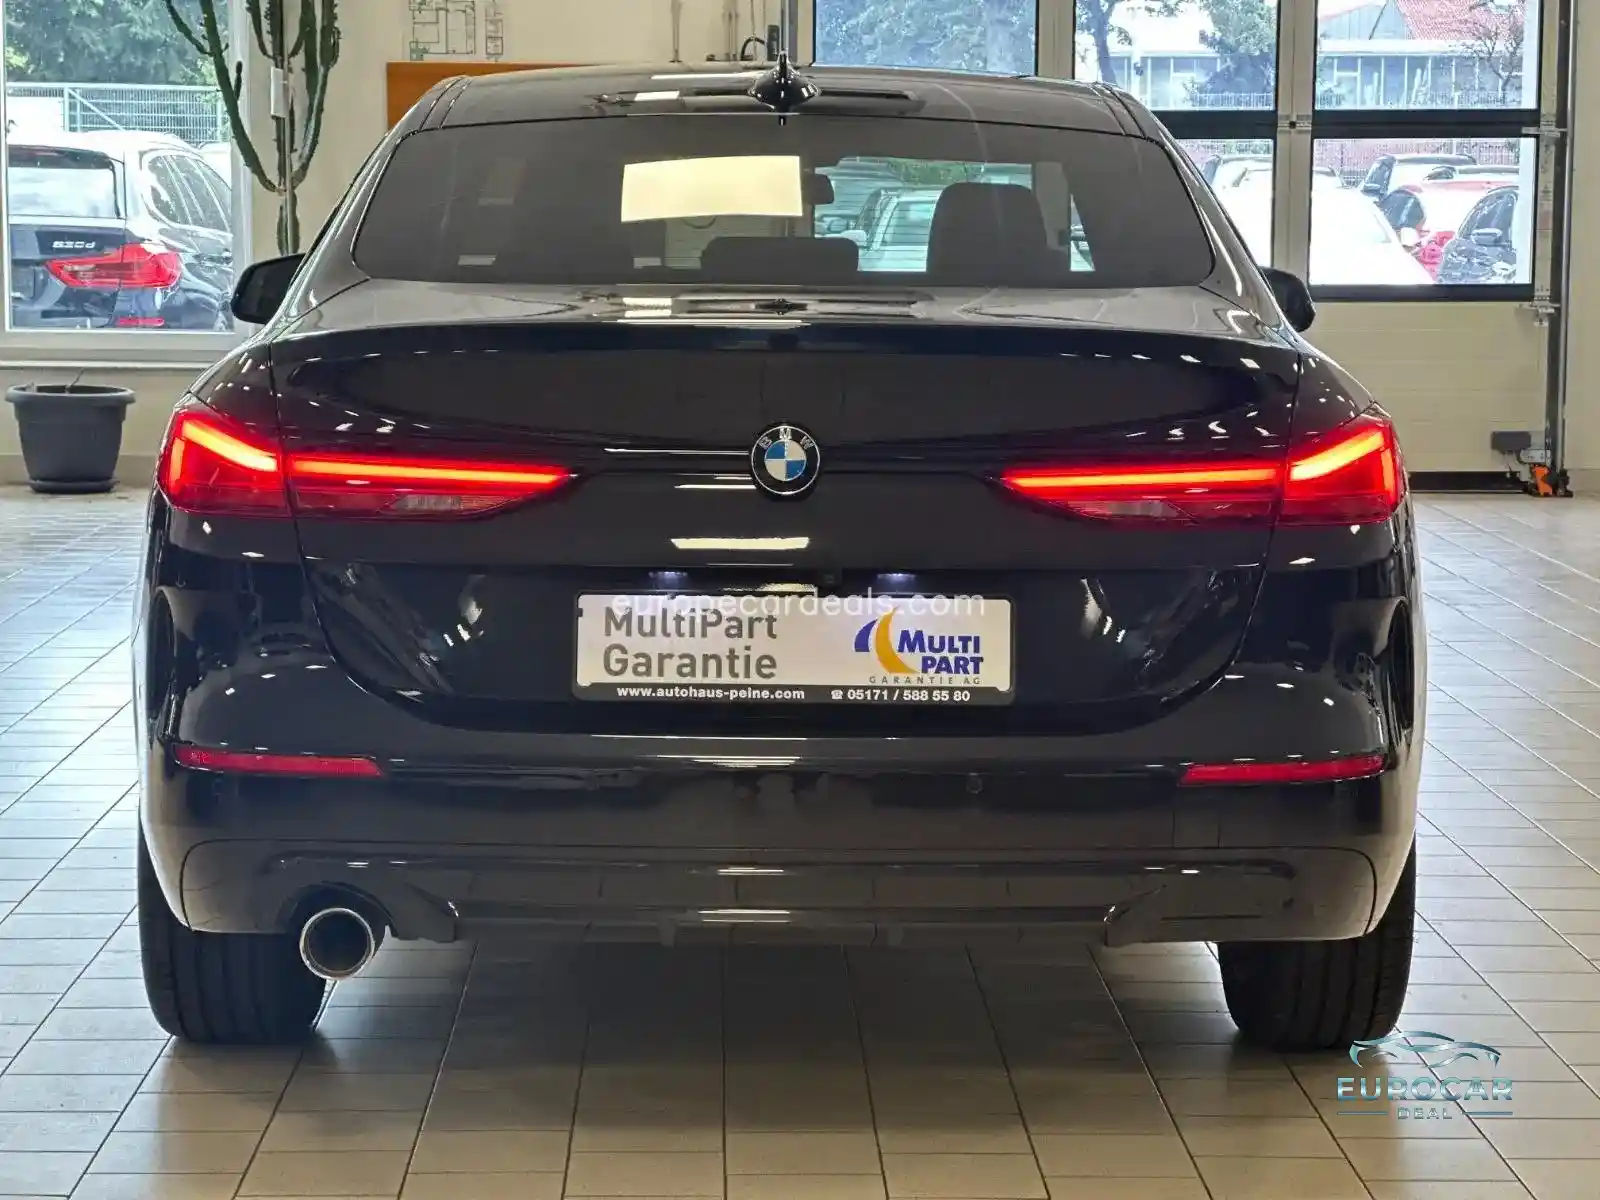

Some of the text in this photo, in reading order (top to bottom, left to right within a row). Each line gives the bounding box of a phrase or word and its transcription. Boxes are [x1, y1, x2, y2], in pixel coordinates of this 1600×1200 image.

[759, 428, 814, 449] BMW
[604, 607, 777, 639] MultiPart
[898, 629, 980, 653] MULTI
[603, 643, 777, 679] Garantie
[921, 656, 984, 674] PART
[869, 676, 981, 684] GARANTIE AG
[617, 686, 805, 700] www.autohaus-peine.com
[847, 690, 888, 700] 05171
[903, 690, 929, 701] 588
[932, 690, 950, 701] 55
[953, 690, 970, 701] 80
